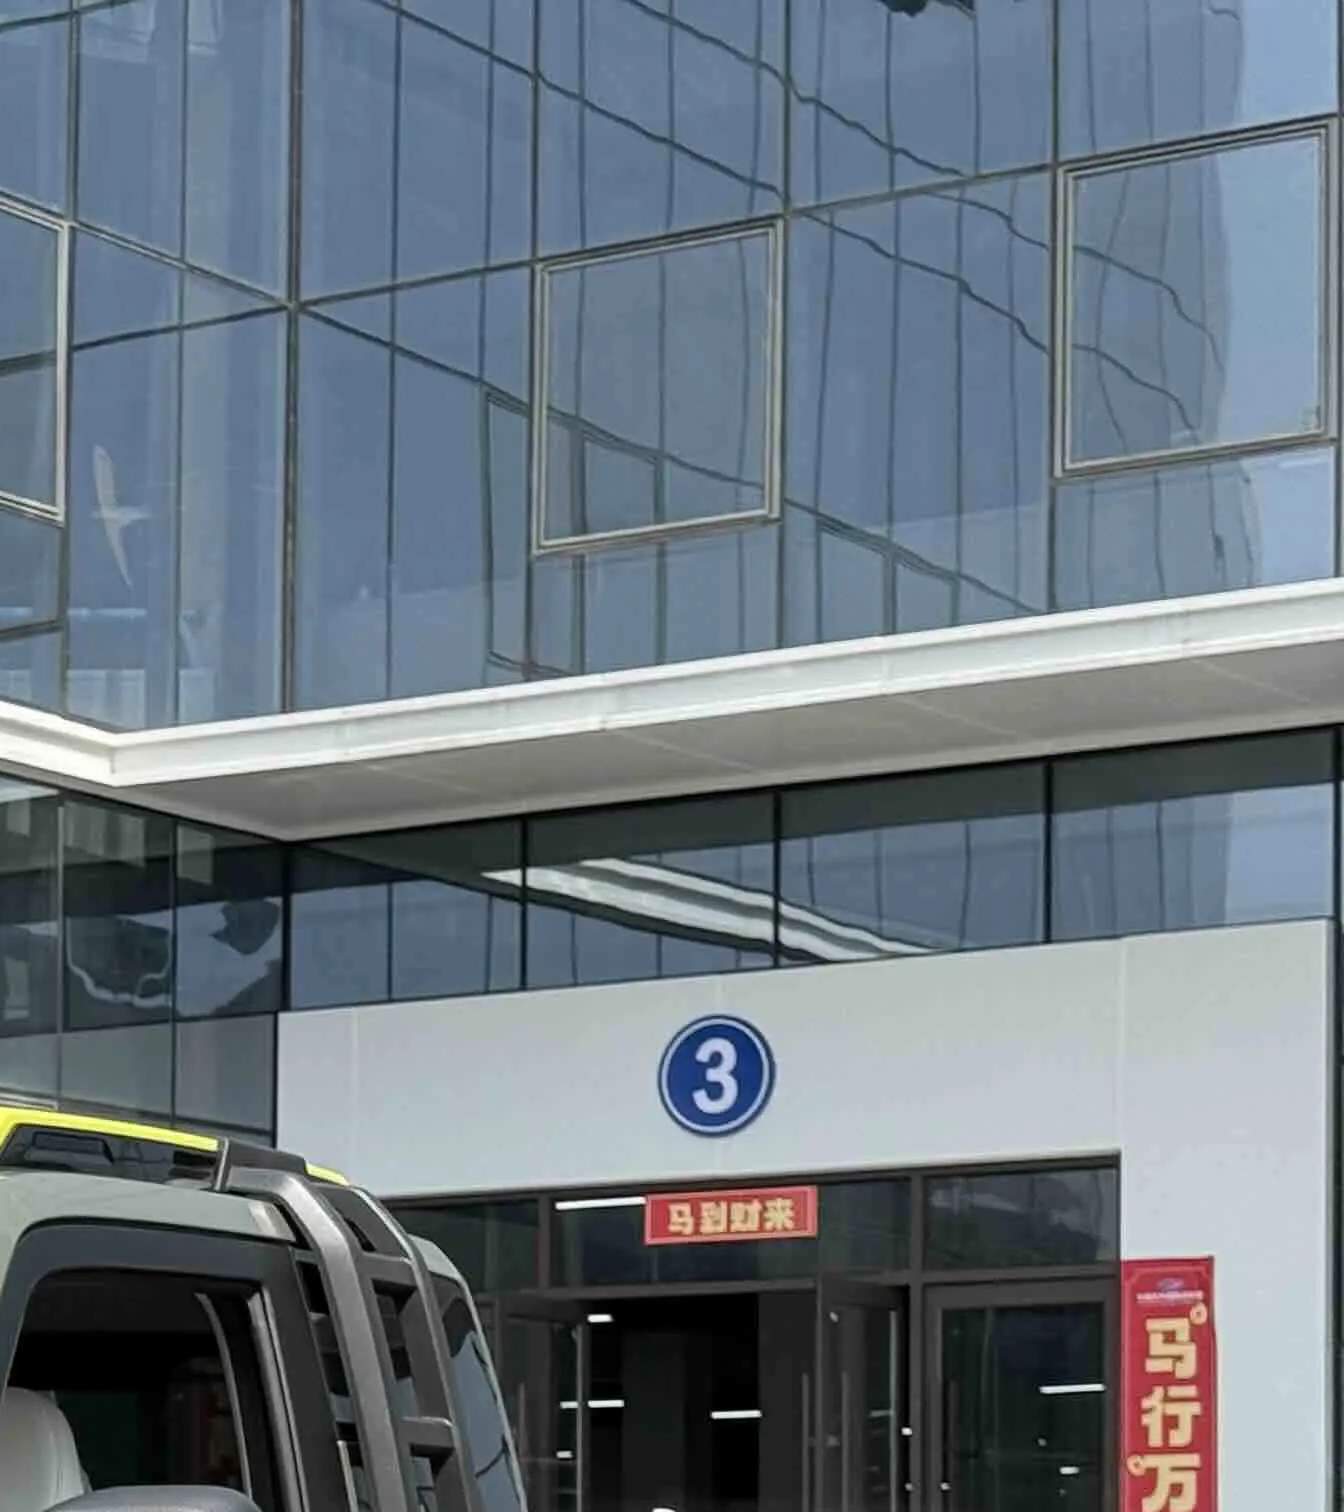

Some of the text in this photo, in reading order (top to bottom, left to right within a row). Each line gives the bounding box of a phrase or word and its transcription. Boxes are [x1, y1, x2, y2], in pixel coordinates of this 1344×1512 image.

[692, 1037, 739, 1114] 3
[667, 1198, 795, 1236] 马到财来
